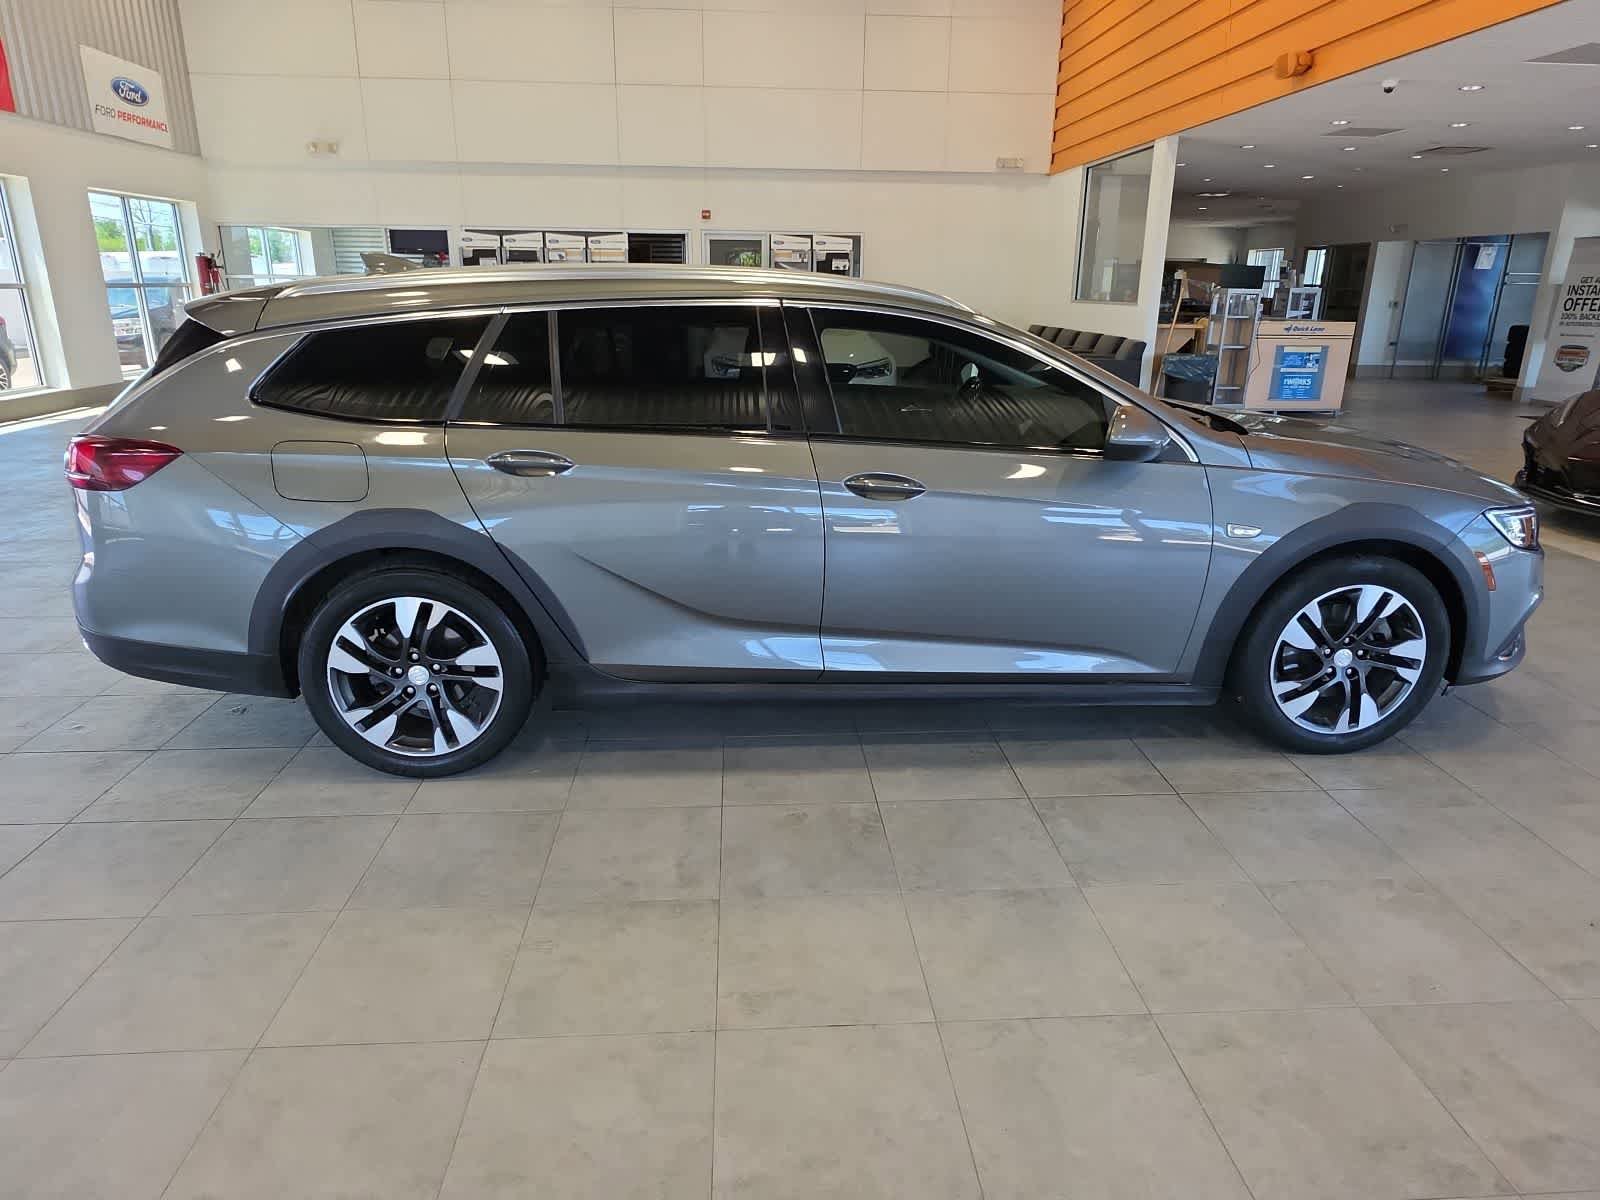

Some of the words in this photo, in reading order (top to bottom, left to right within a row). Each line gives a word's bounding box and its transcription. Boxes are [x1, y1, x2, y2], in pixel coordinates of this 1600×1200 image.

[118, 80, 143, 103] Ford
[95, 104, 116, 120] FORD
[1567, 284, 1600, 297] INSTA
[1563, 297, 1600, 312] OFFE
